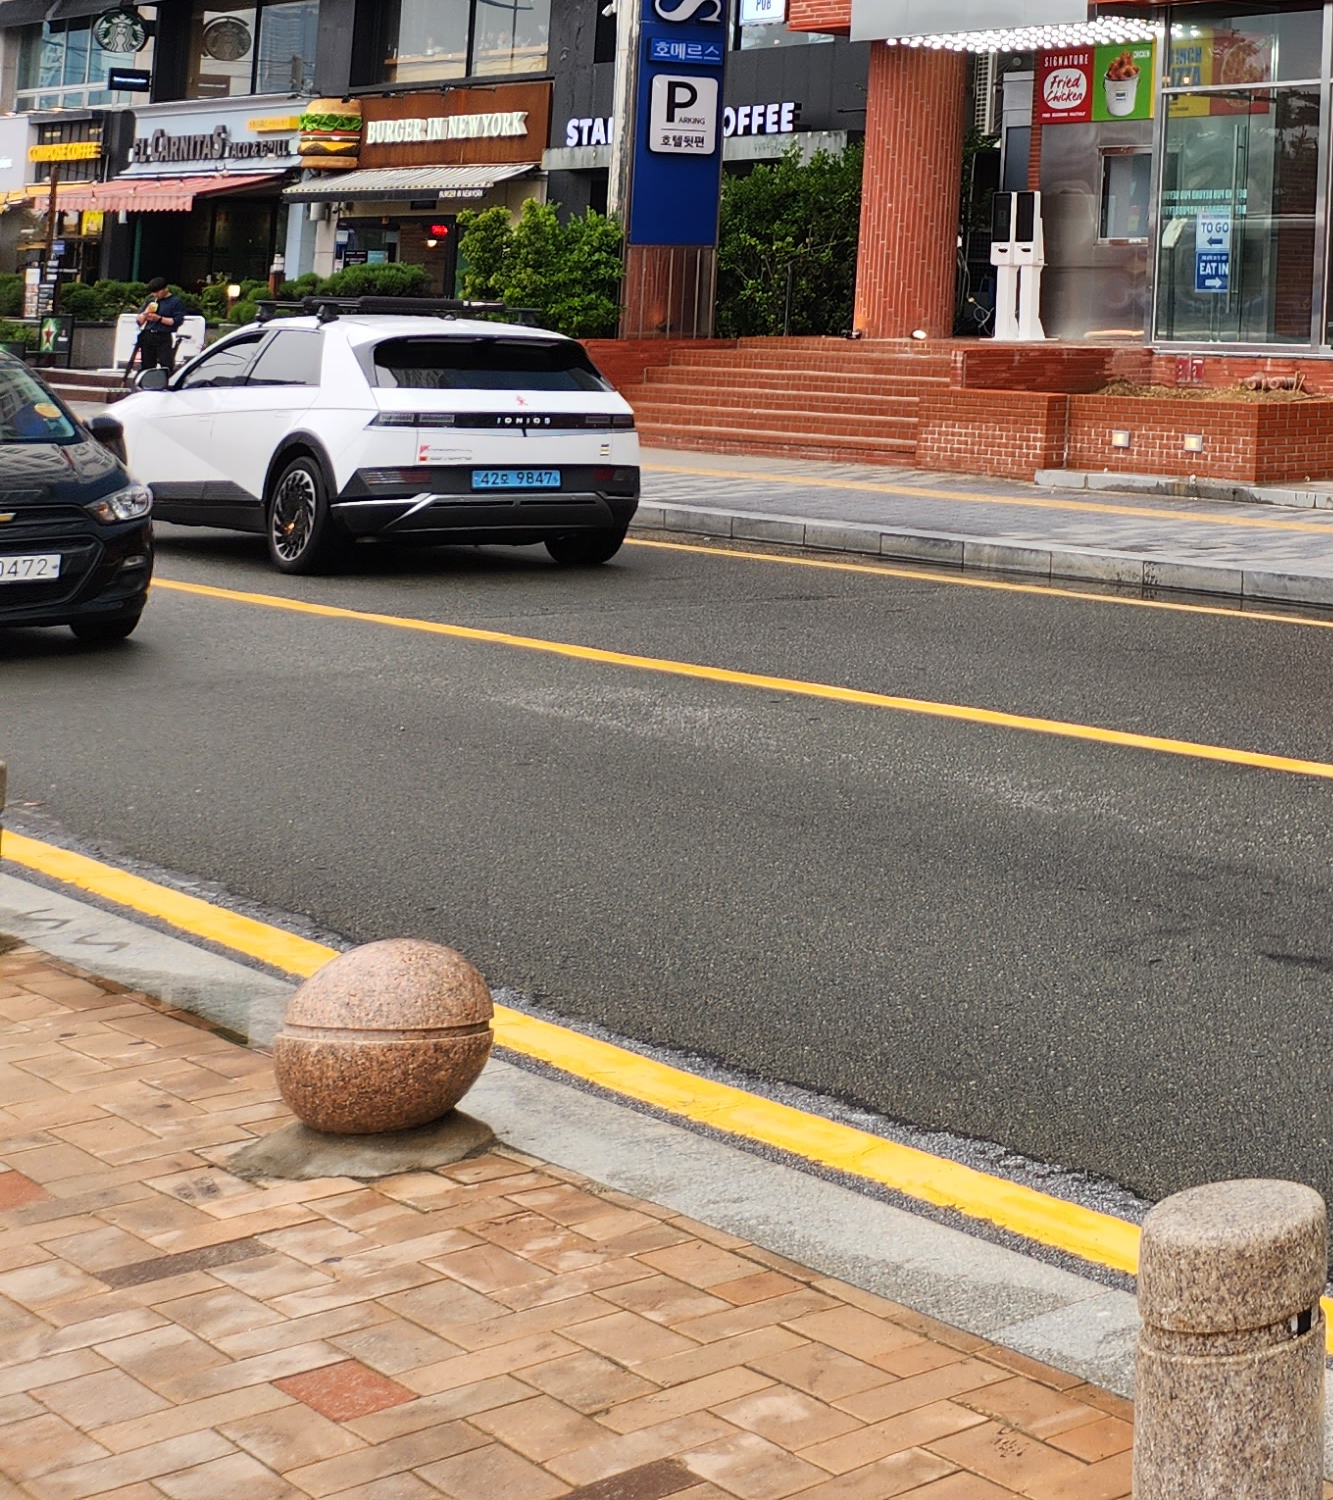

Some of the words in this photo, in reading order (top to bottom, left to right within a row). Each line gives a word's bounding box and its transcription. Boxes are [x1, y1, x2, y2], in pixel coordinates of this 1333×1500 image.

[653, 41, 721, 61] 호메르스
[1044, 54, 1089, 67] SIGNATURE
[1050, 73, 1082, 90] Fried
[1046, 88, 1083, 102] Chicken
[723, 102, 794, 137] OFFEE
[366, 118, 427, 144] BURGER
[427, 117, 447, 141] IN
[566, 117, 614, 147] STA
[660, 134, 705, 149] 호텔뒷편
[1201, 221, 1213, 234] TO
[1215, 221, 1229, 234] GO
[1199, 262, 1217, 275] EAT
[1218, 262, 1229, 275] IN
[516, 471, 553, 484] 9847
